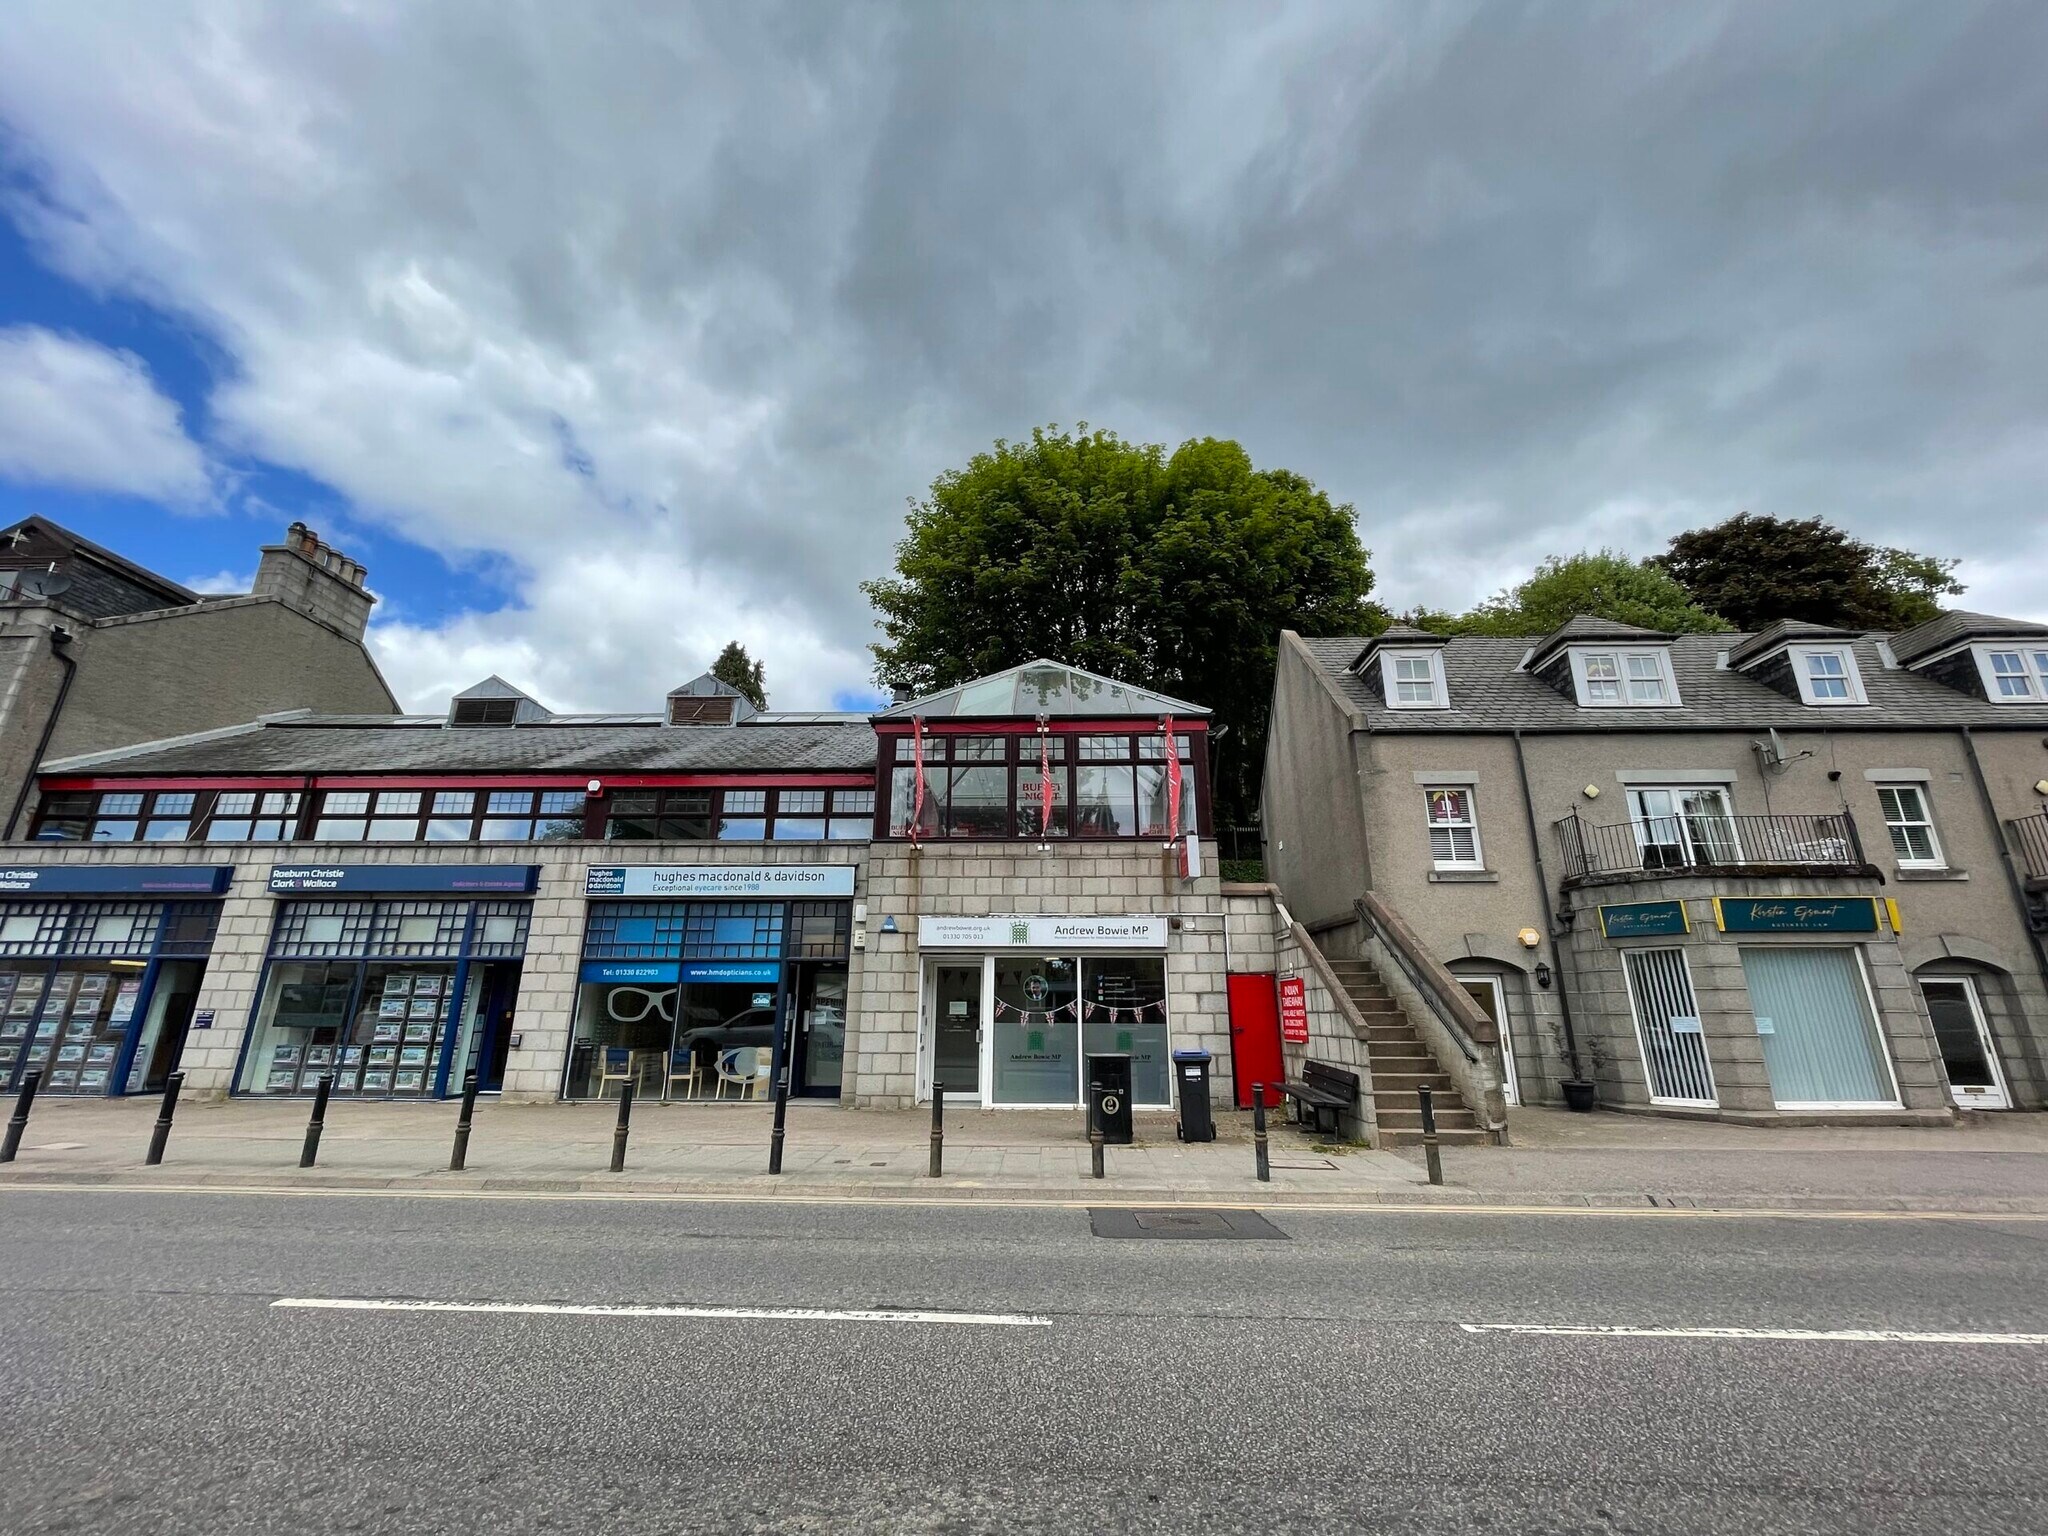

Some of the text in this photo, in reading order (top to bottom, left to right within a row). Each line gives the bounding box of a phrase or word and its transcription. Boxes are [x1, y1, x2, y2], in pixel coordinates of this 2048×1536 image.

[1022, 783, 1062, 792] BUFET
[1025, 793, 1060, 801] NIGT
[272, 870, 345, 878] Raeburn Christie
[654, 871, 825, 883] hughes macdonald & davidson
[271, 880, 295, 888] Clark
[302, 880, 337, 888] Wallace
[652, 884, 693, 892] Exceptional
[694, 884, 722, 892] eyecare
[1054, 925, 1149, 935] Andrew Bowie MP
[690, 969, 771, 977] www.hmdopticians.co.uk
